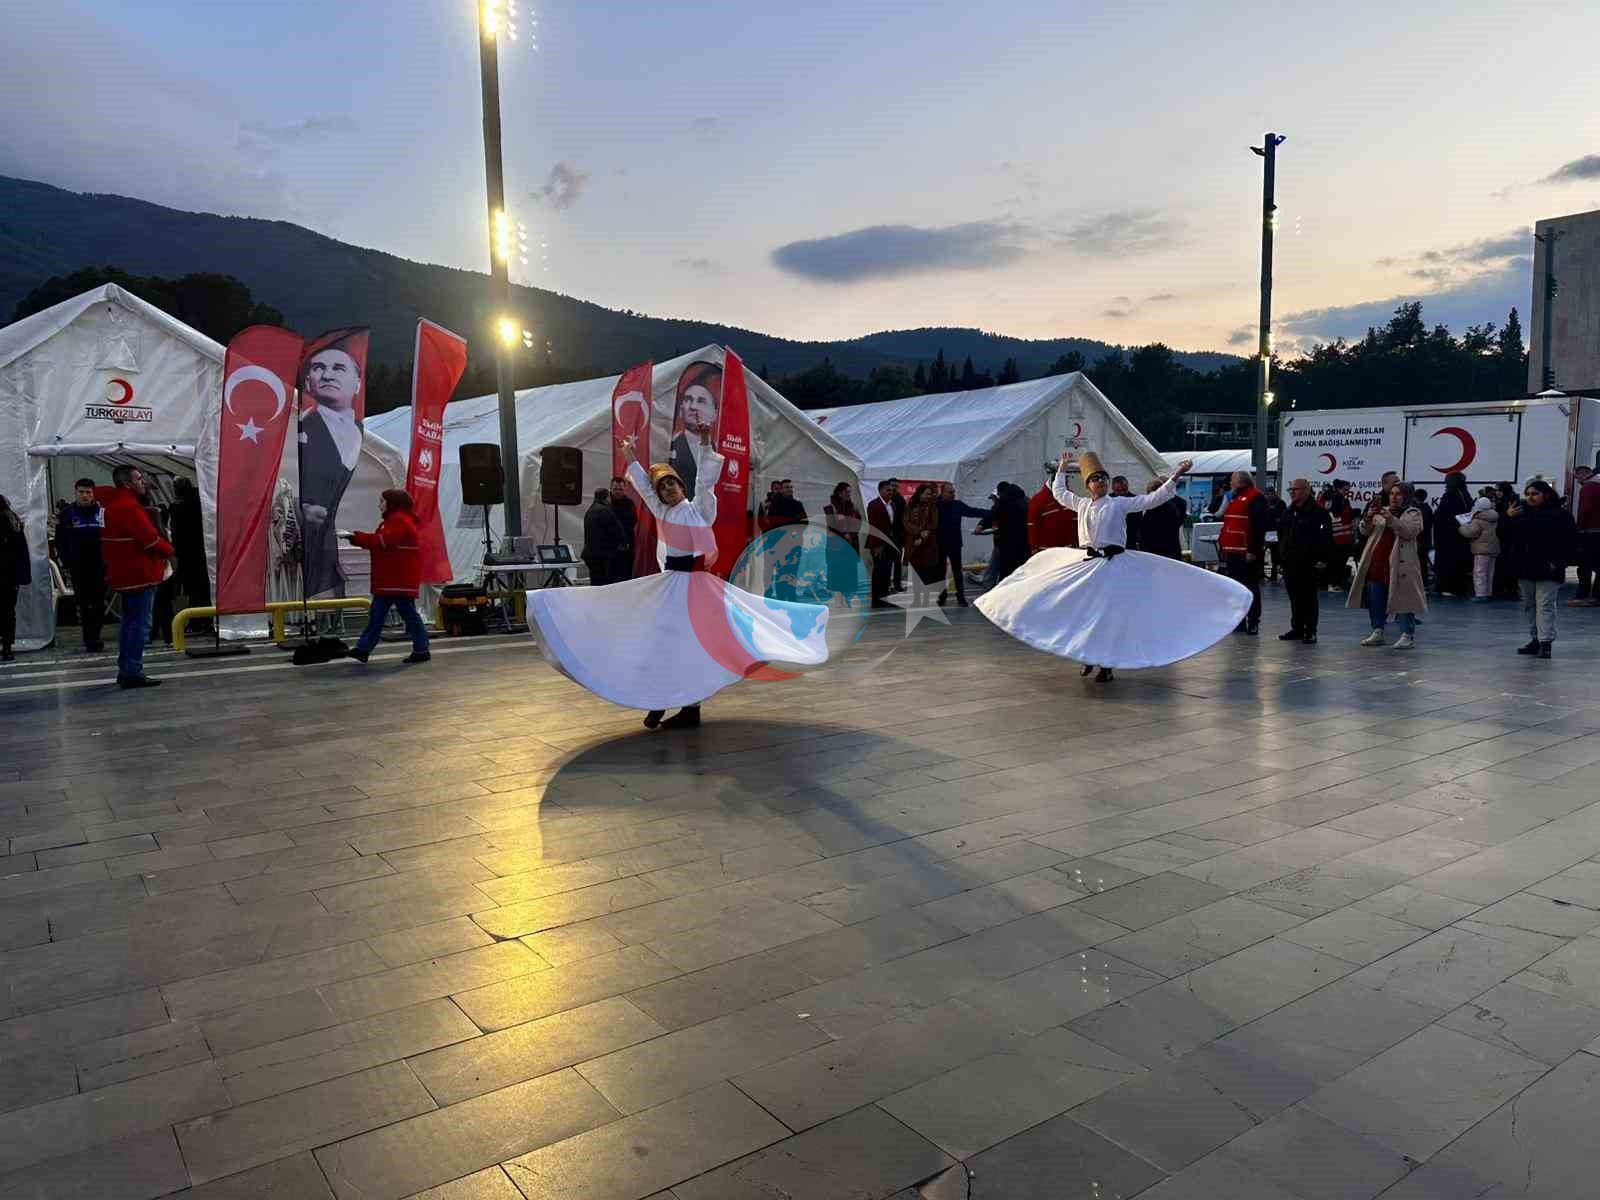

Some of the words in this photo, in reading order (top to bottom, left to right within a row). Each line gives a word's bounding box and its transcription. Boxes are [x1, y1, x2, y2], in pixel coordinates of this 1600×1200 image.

[1293, 429, 1324, 437] MERHUM
[1326, 428, 1351, 436] ORHAN
[1294, 440, 1317, 448] ADINA
